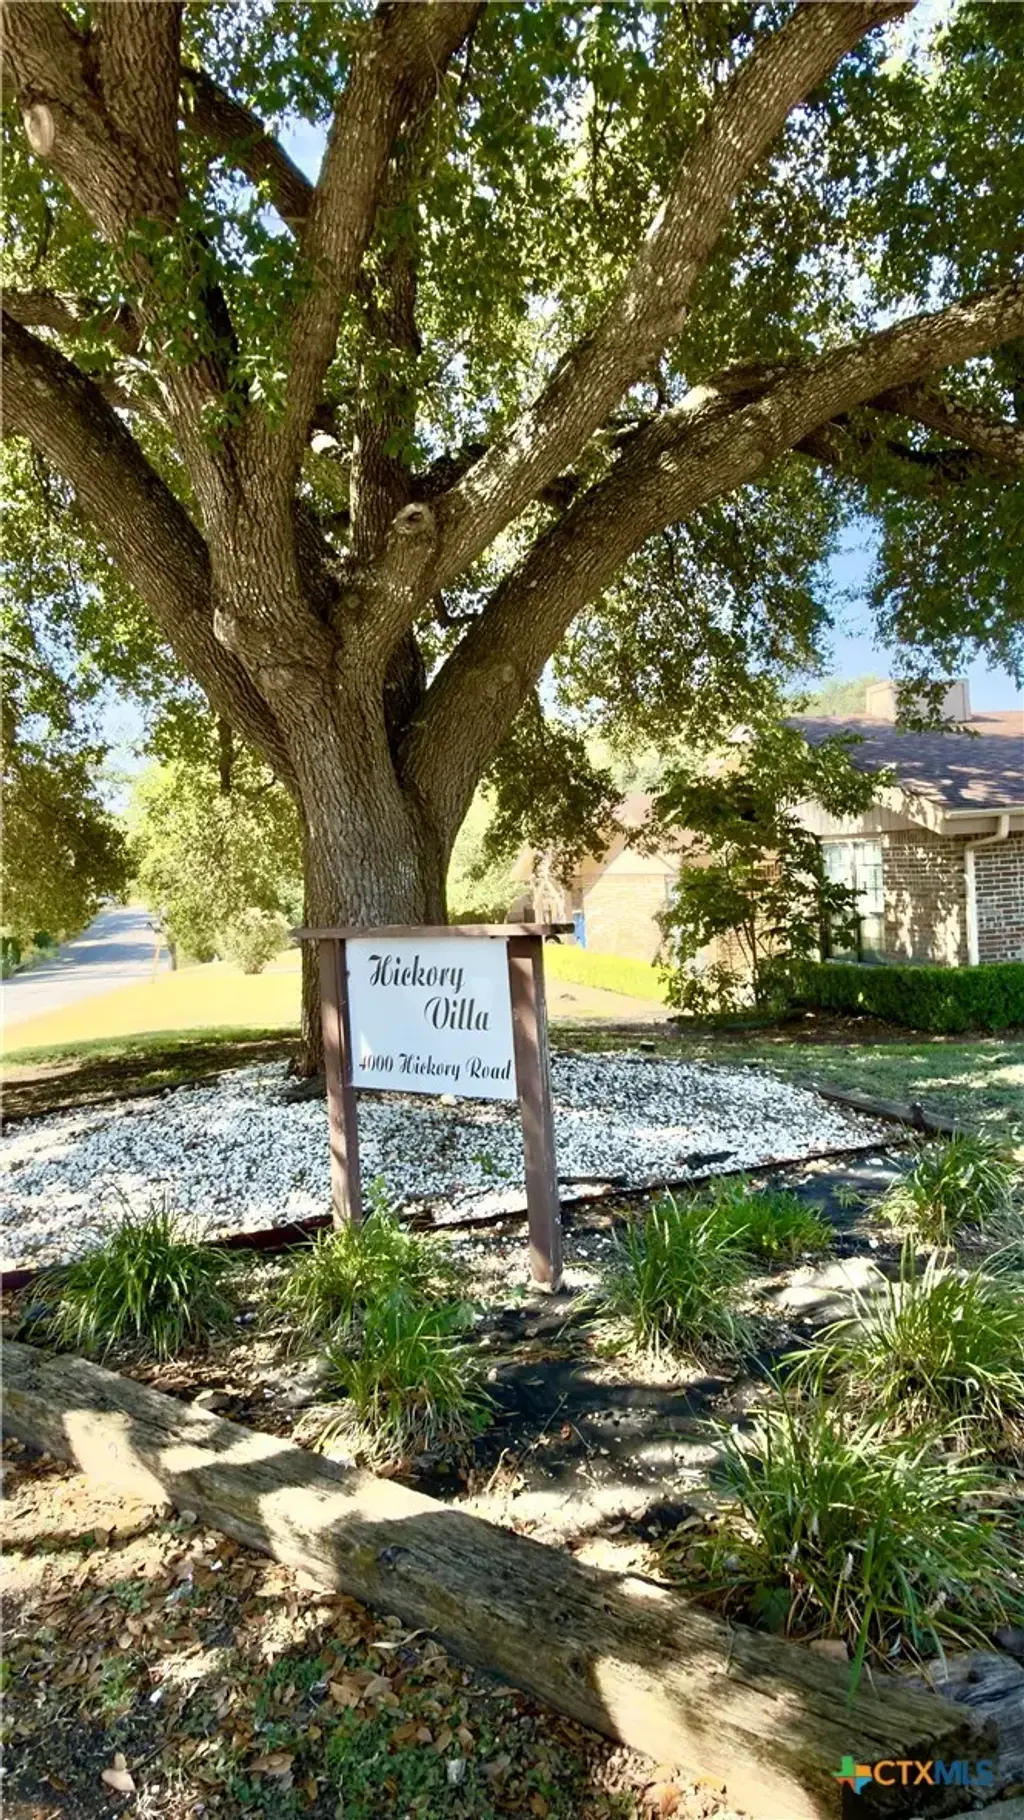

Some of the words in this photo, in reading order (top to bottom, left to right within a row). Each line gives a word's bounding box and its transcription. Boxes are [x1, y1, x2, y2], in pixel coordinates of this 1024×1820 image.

[368, 954, 465, 994] Hickory
[424, 996, 491, 1031] Villa
[359, 1054, 394, 1073] 4000
[399, 1053, 460, 1081] Hickory
[465, 1057, 512, 1080] Road
